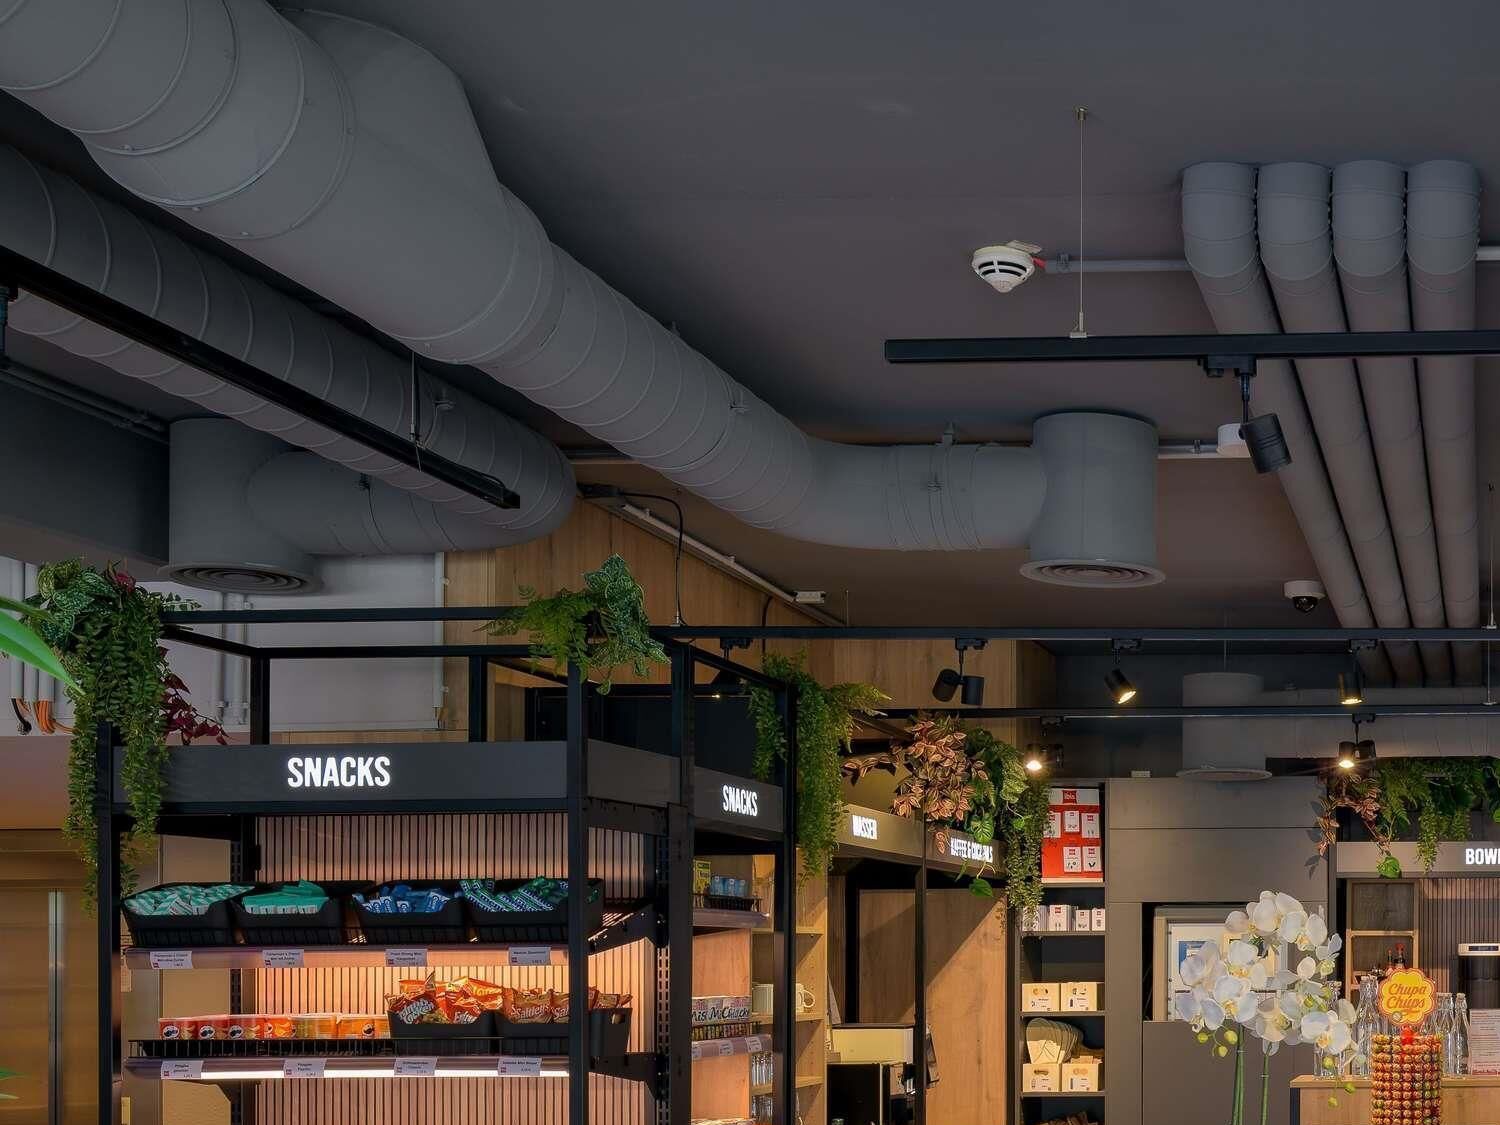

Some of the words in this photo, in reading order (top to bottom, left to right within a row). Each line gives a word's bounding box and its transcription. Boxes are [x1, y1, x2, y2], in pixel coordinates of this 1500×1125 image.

[287, 756, 391, 788] SNACKS
[722, 785, 758, 817] SNACKS
[1388, 983, 1427, 998] Chupa
[1386, 996, 1425, 1009] Chups
